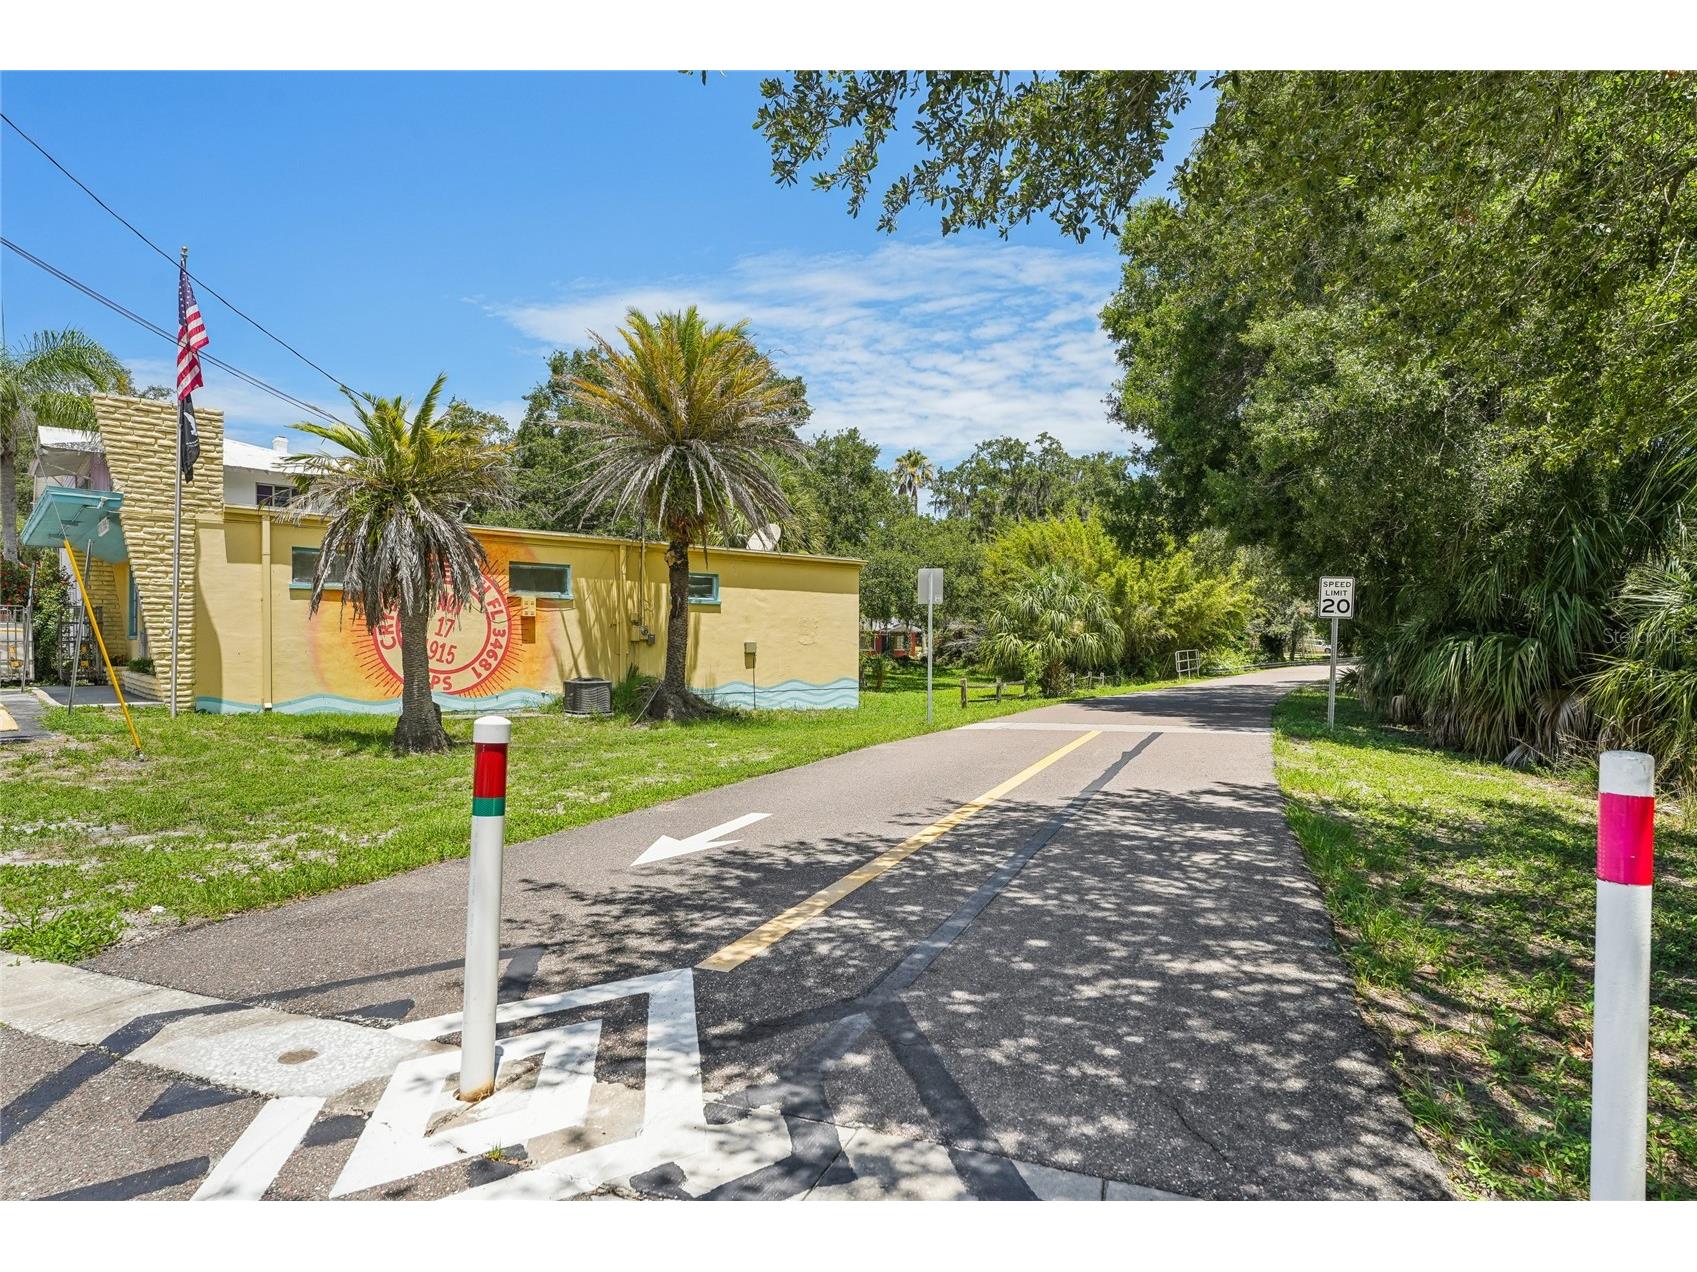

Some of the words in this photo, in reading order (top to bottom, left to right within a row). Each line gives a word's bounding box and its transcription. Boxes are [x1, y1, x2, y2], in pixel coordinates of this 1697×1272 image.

[486, 597, 504, 620] FL
[1321, 598, 1351, 614] 20
[434, 616, 456, 638] 17
[426, 638, 457, 665] 915
[471, 627, 506, 680] 34681
